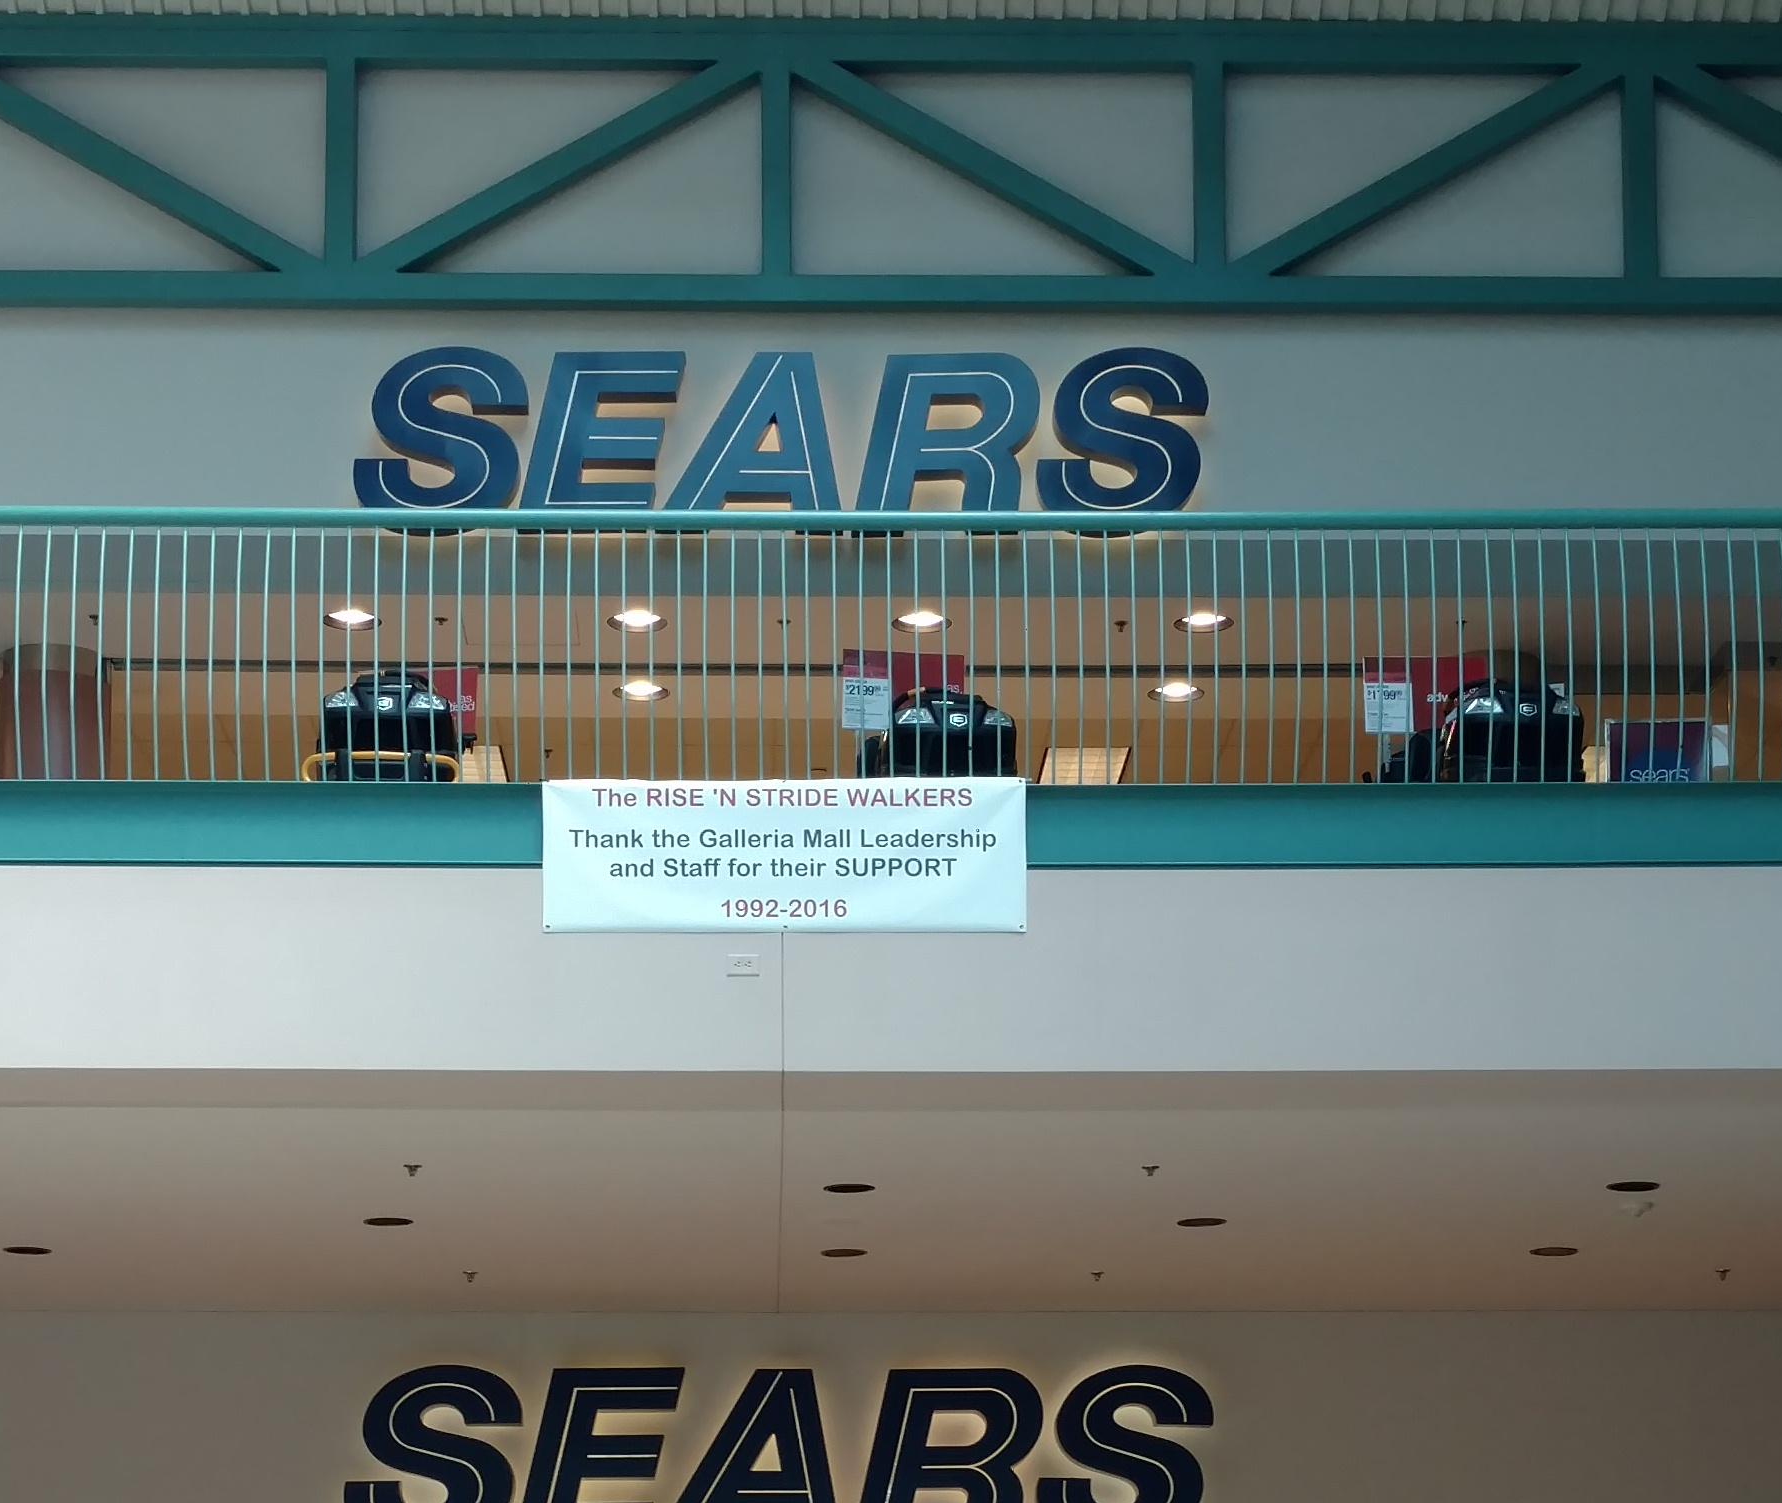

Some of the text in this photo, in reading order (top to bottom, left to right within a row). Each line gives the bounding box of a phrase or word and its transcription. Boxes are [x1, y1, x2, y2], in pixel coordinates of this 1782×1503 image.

[353, 345, 1210, 537] SEARS
[592, 788, 973, 808] The RISE 'N STRIDE WALKERS
[569, 828, 997, 852] Thank the Galleria Mall Leadership
[609, 858, 957, 878] and Staff for their SUPPORT
[720, 899, 848, 919] 1992-2016
